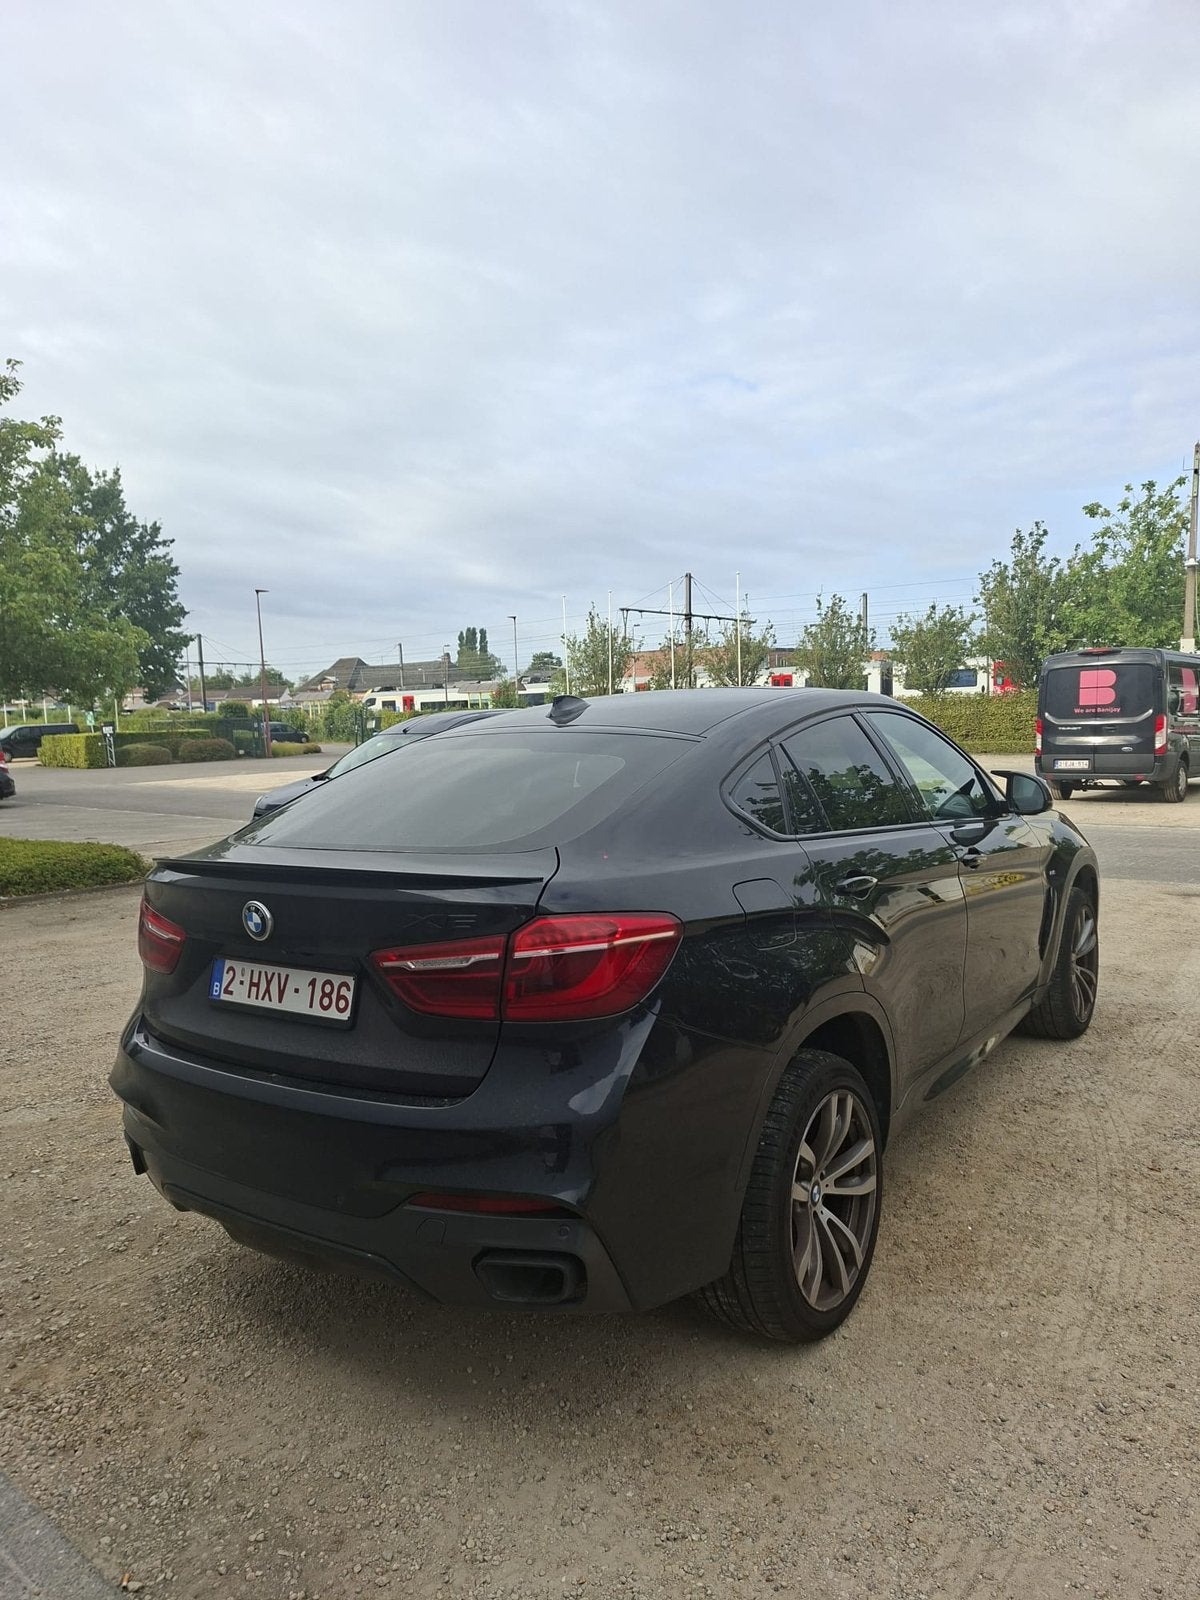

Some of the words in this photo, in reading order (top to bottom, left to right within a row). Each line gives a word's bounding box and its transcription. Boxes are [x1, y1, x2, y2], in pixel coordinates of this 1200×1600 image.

[1079, 669, 1117, 706] B
[213, 982, 220, 996] B
[222, 965, 351, 1014] 2-HXV-186
